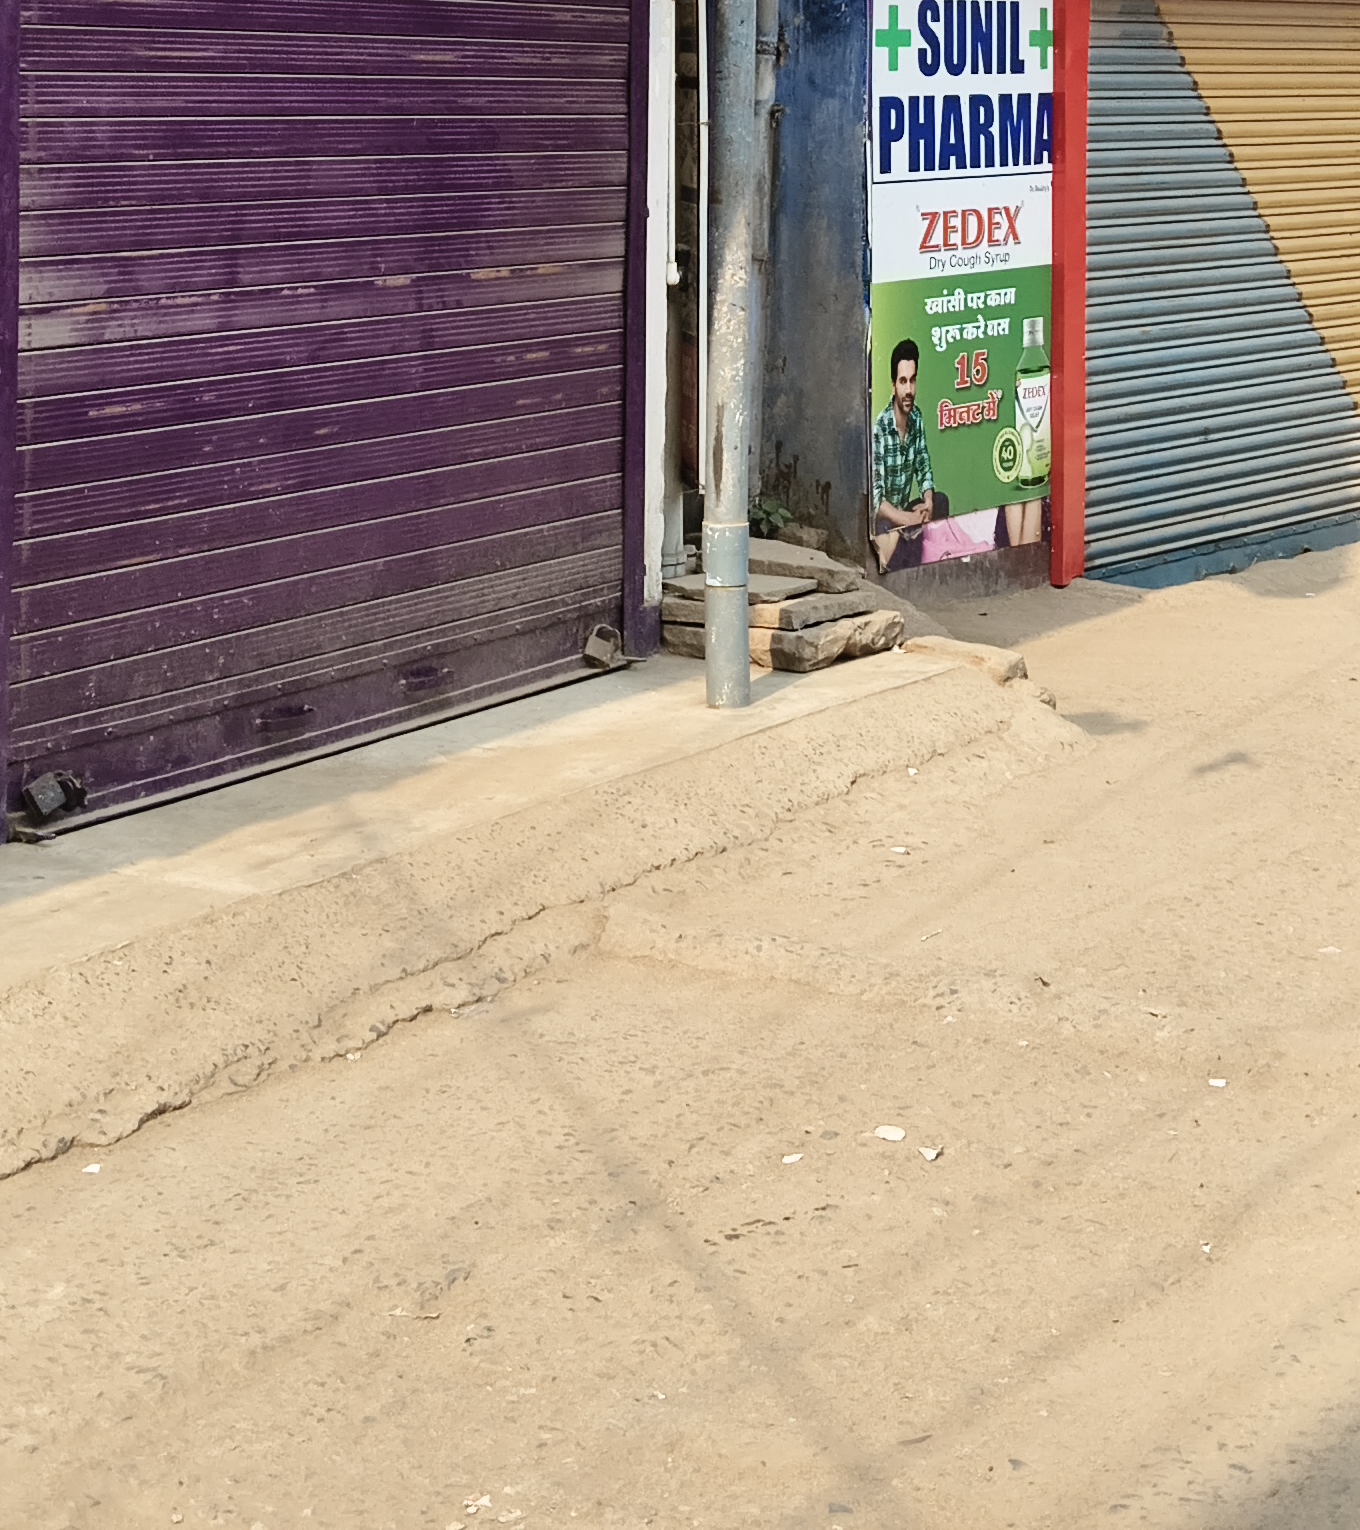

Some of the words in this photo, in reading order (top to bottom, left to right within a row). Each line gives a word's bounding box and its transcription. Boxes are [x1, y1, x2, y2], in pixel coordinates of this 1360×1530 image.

[878, 91, 1053, 175] PHARMA
[919, 203, 1025, 254] ZEDEX
[928, 255, 947, 273] Dry
[948, 252, 982, 270] Cough
[983, 250, 1011, 268] Syrup
[953, 349, 989, 390] 15
[1022, 384, 1046, 400] ZEDEX
